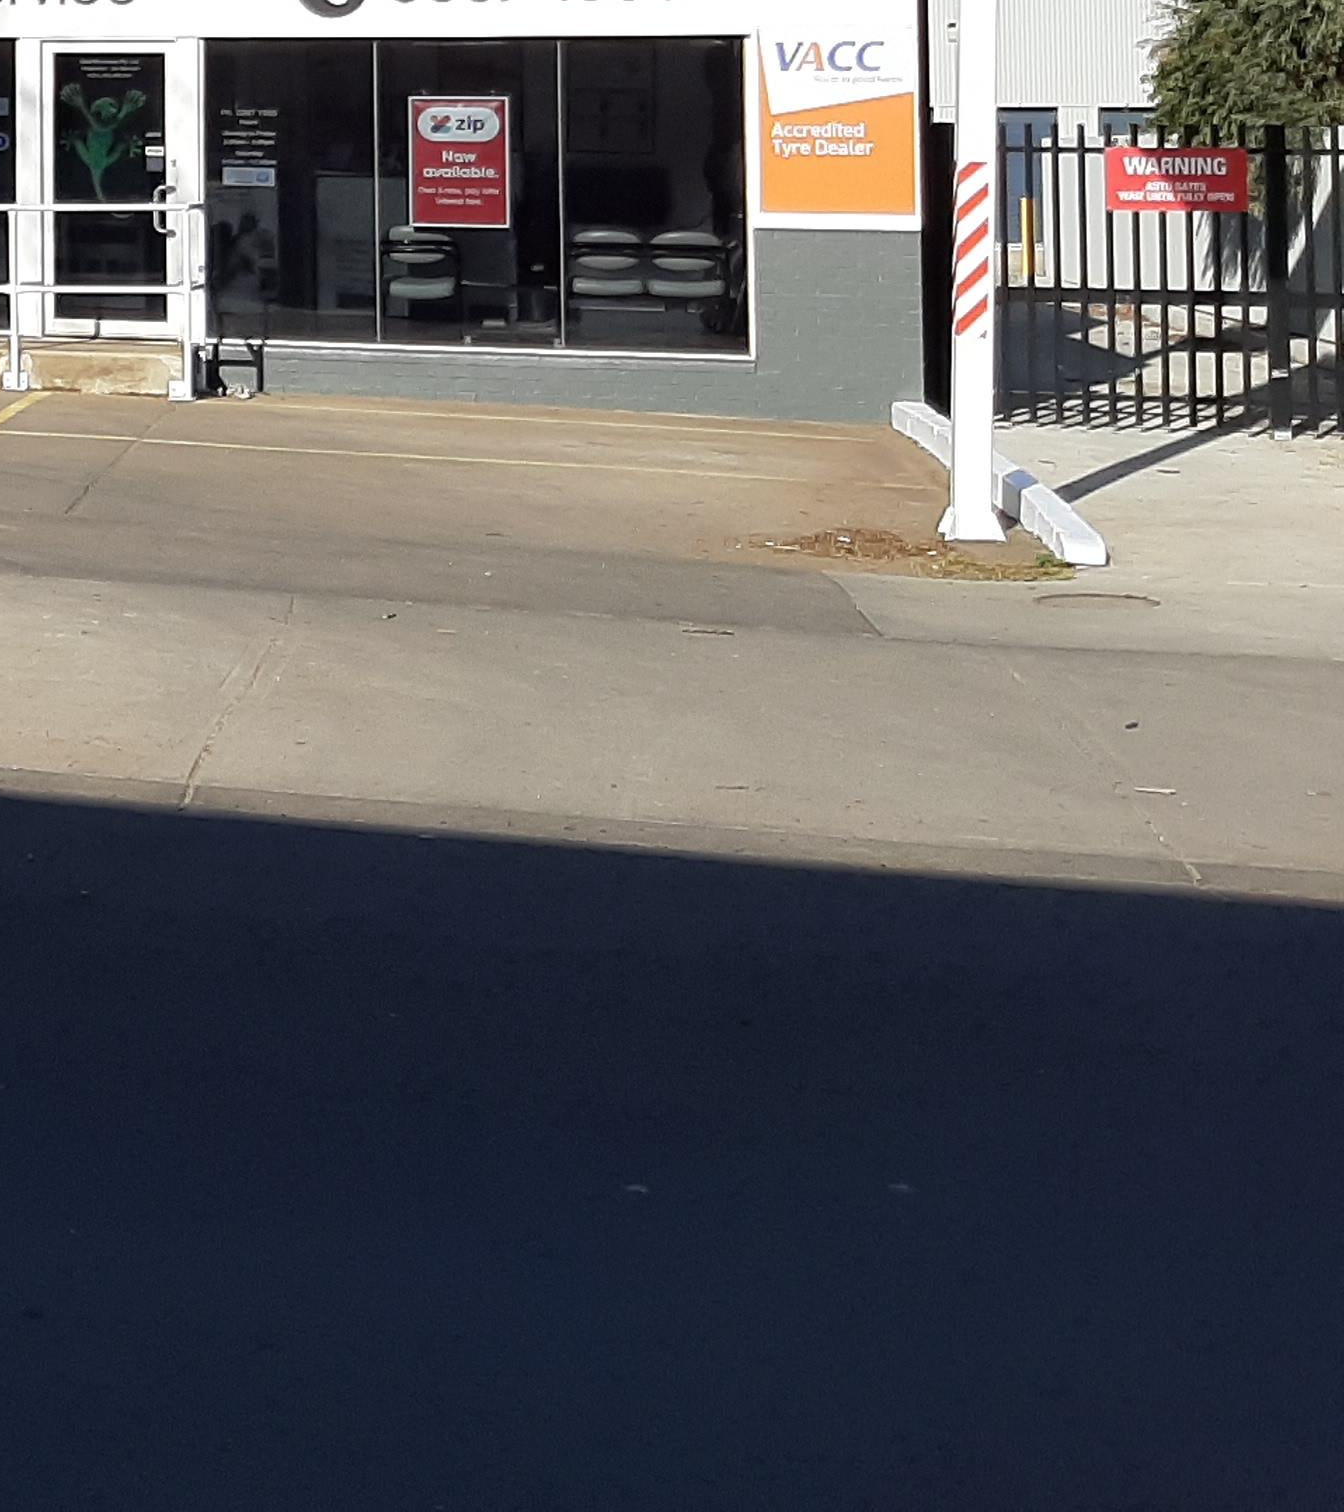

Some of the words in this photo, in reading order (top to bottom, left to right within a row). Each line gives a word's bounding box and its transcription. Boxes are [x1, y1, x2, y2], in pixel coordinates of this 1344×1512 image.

[775, 41, 884, 72] VACC
[455, 115, 485, 134] zip
[771, 122, 865, 138] Accredited
[442, 150, 478, 163] Now
[772, 139, 811, 158] Tyre
[815, 139, 874, 156] Dealer
[1122, 156, 1228, 176] WARNING
